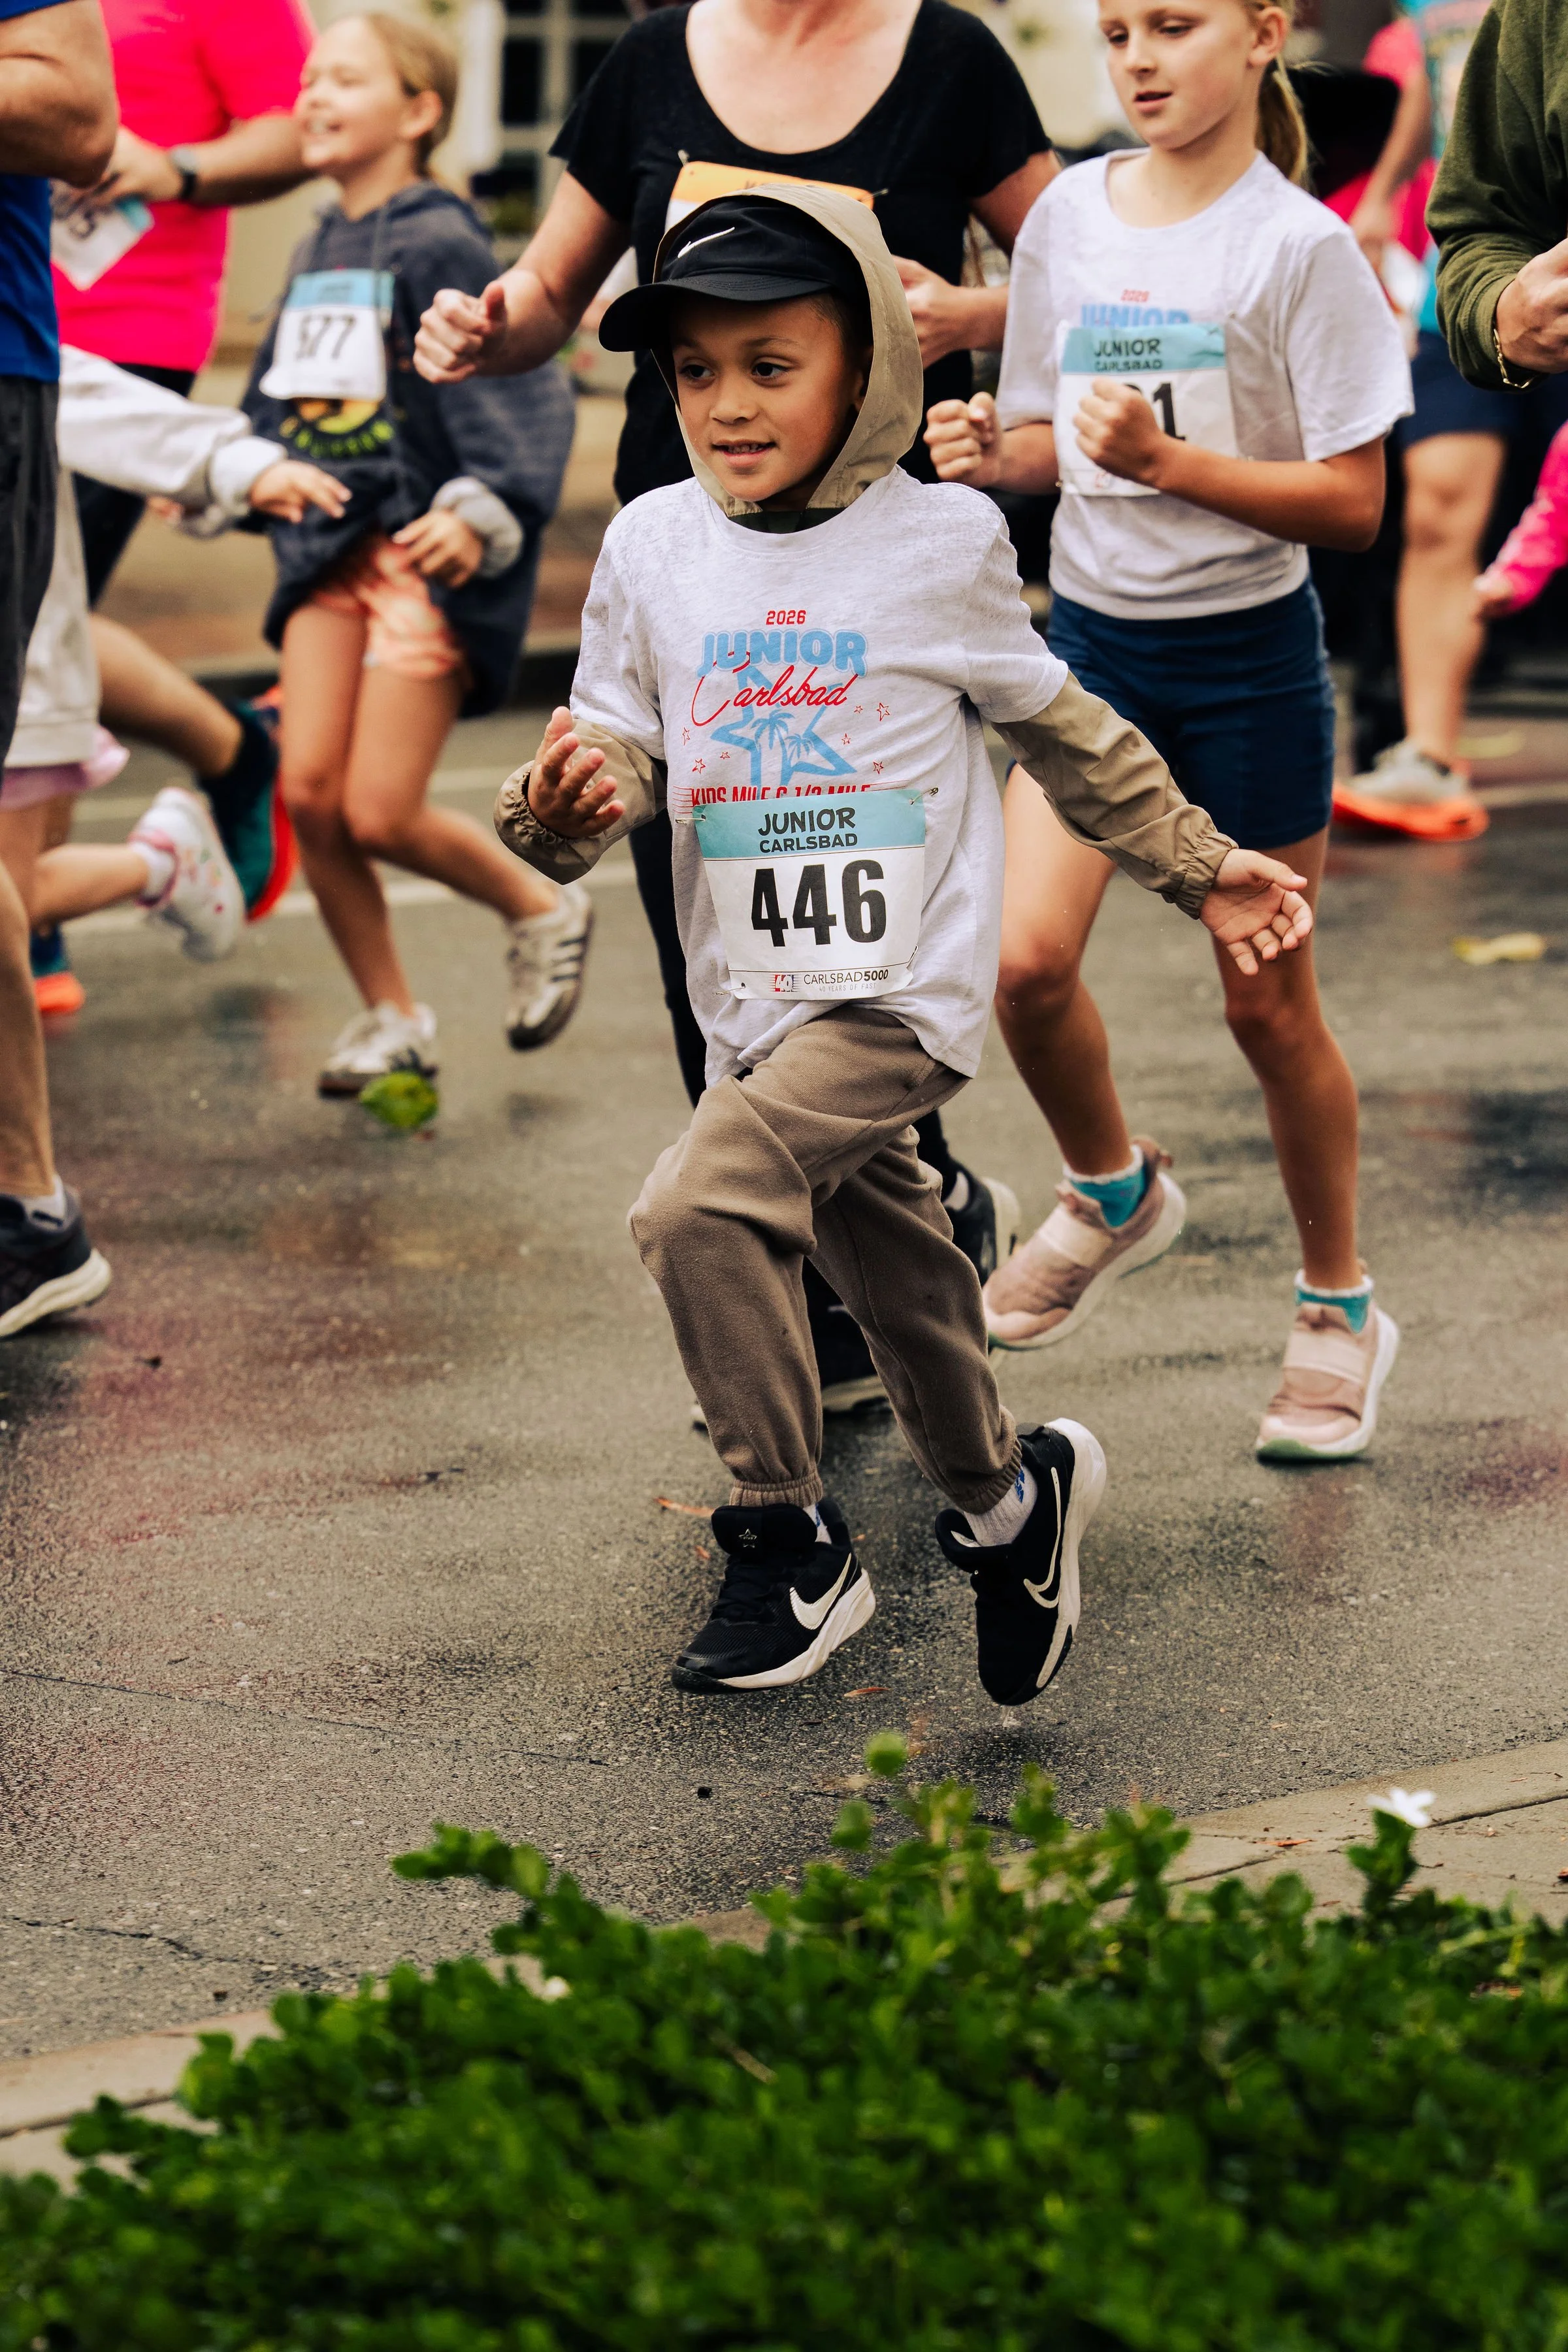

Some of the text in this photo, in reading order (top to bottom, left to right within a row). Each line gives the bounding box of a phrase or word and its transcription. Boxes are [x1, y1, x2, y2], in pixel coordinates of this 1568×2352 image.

[1094, 338, 1160, 357] JUNIOR
[1094, 359, 1162, 372] CARLSBAD
[766, 610, 807, 625] 2026
[696, 629, 868, 678] JUNIOR
[691, 651, 858, 727] Carlsbad
[758, 807, 856, 836] JUNIOR
[759, 833, 858, 853] CARLSBAD
[751, 859, 887, 947] 446
